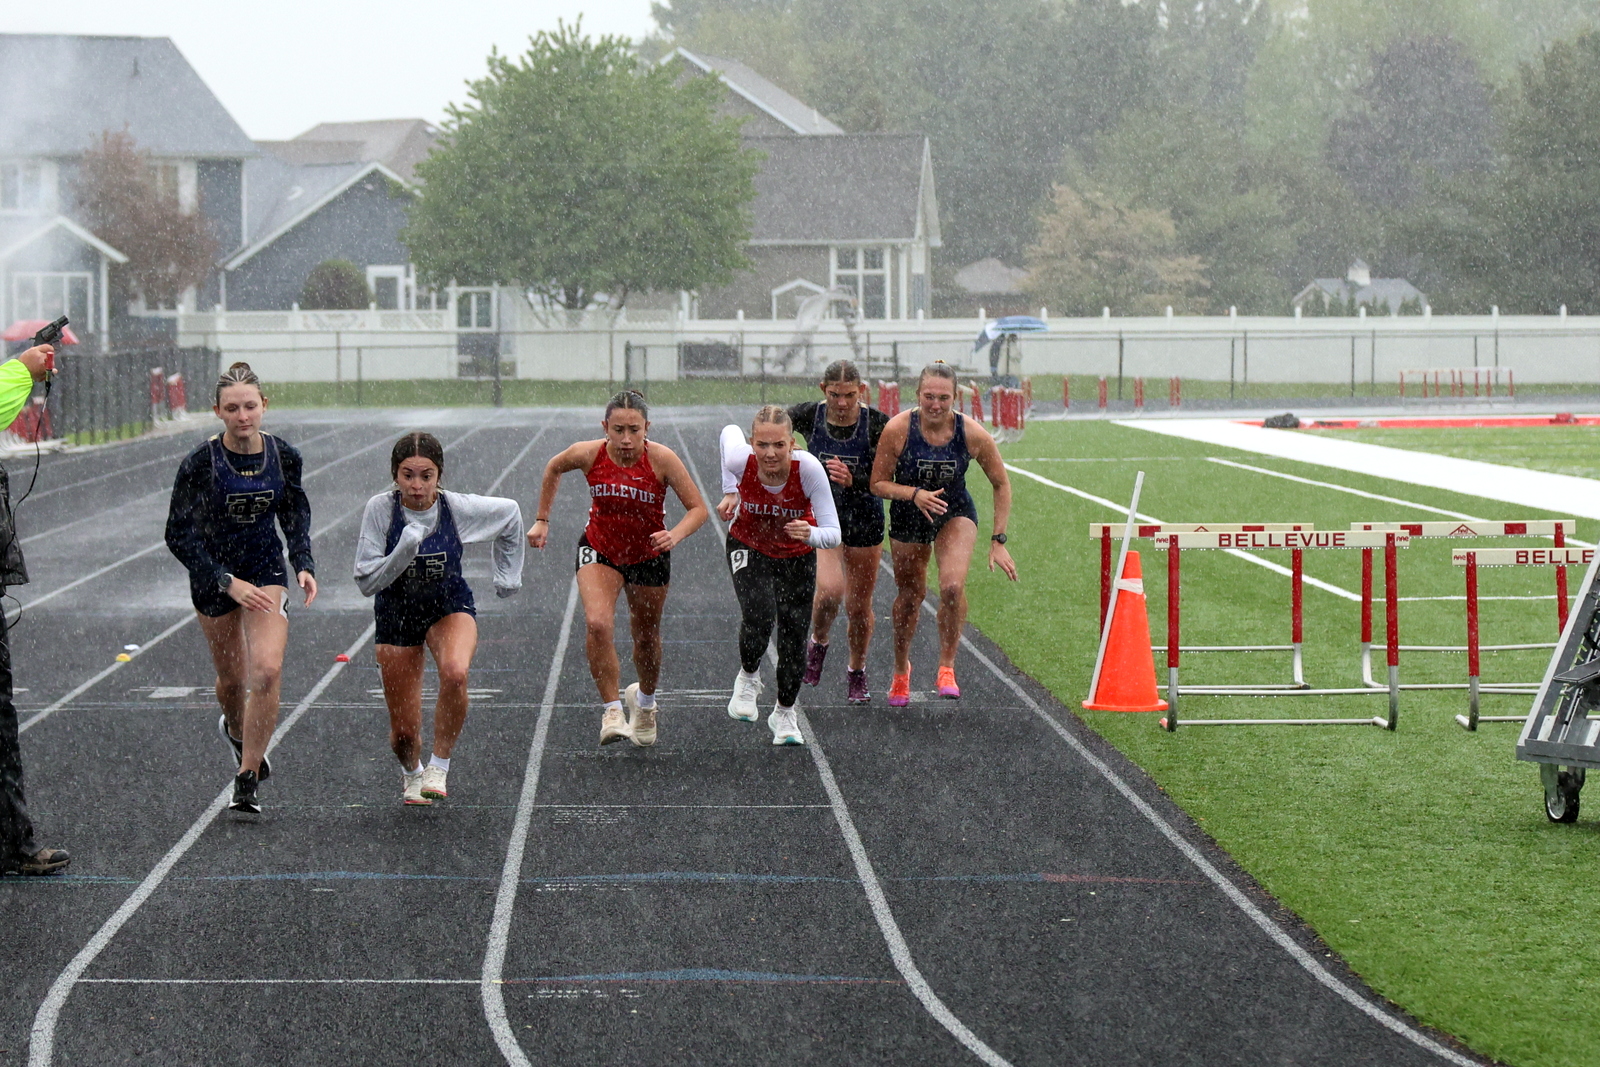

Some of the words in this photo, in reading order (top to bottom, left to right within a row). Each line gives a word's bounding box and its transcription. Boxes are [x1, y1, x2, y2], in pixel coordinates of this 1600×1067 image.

[590, 484, 656, 504] BELLEVUE
[743, 501, 805, 519] BELLEVUE
[1218, 532, 1346, 548] BELLEVUE
[581, 547, 593, 565] 8
[733, 550, 745, 569] 9
